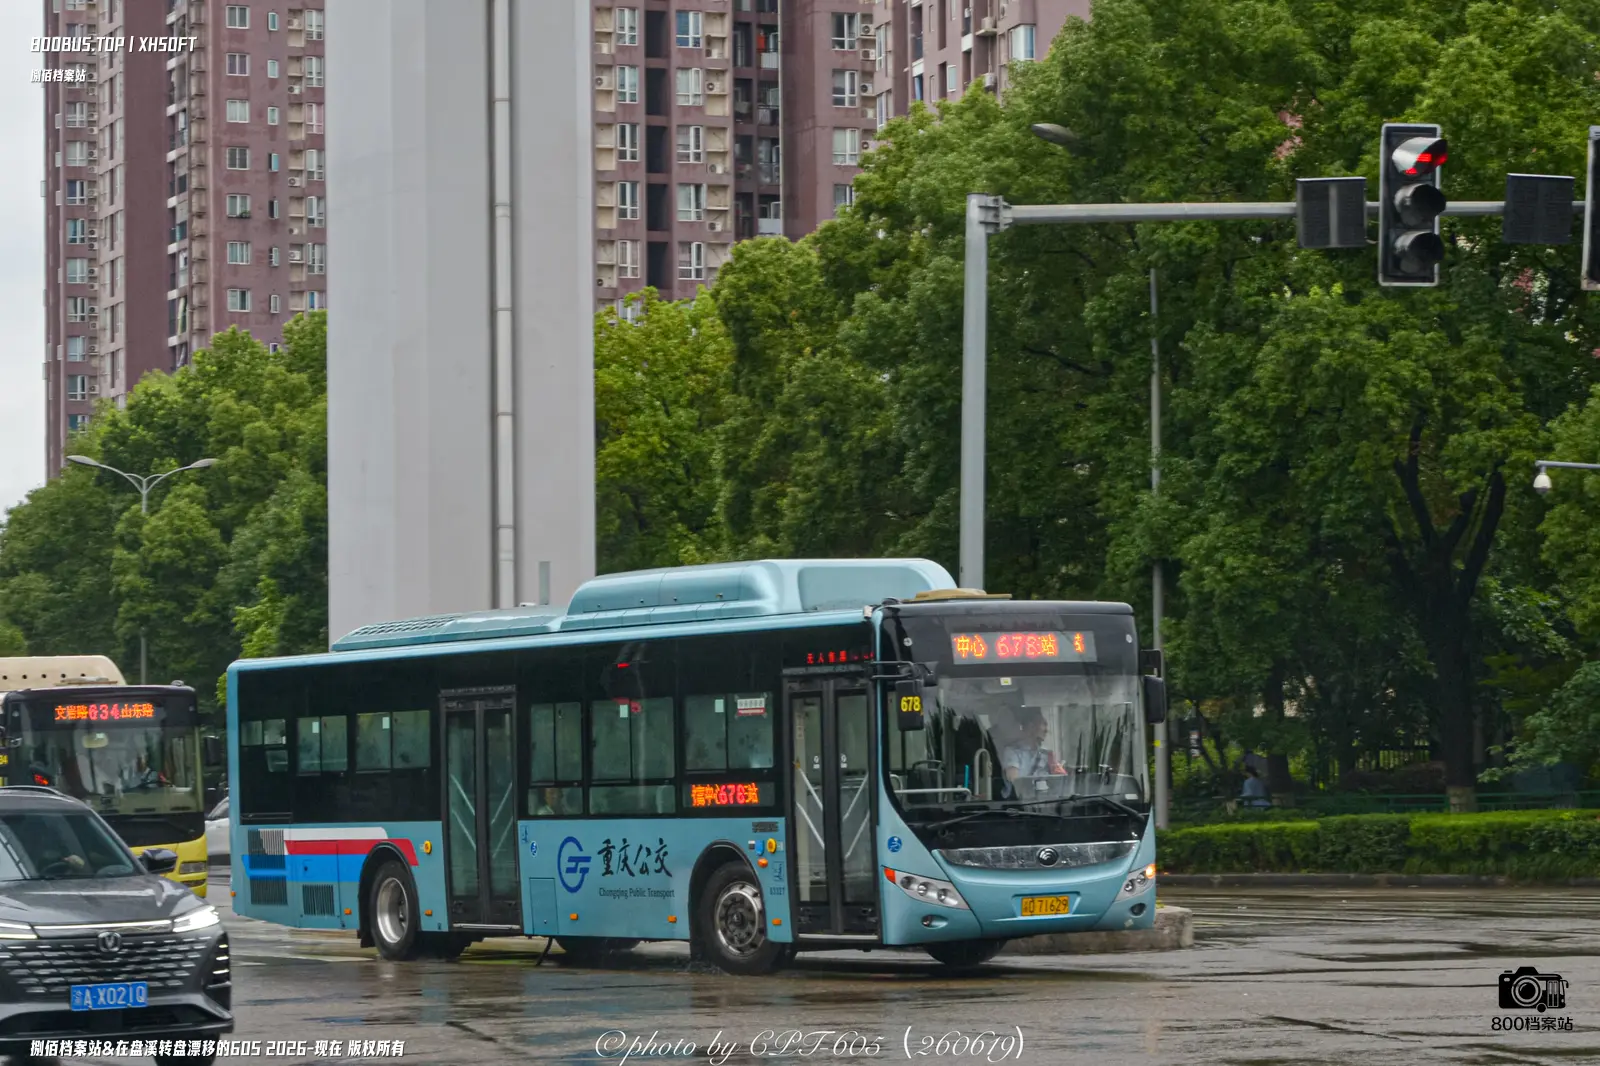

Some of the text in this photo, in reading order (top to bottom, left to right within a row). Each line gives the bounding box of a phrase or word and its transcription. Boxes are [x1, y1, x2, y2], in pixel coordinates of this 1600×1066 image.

[900, 696, 921, 712] 678
[597, 837, 673, 878] 重庆公交
[599, 887, 675, 900] Chongqing Public Transport
